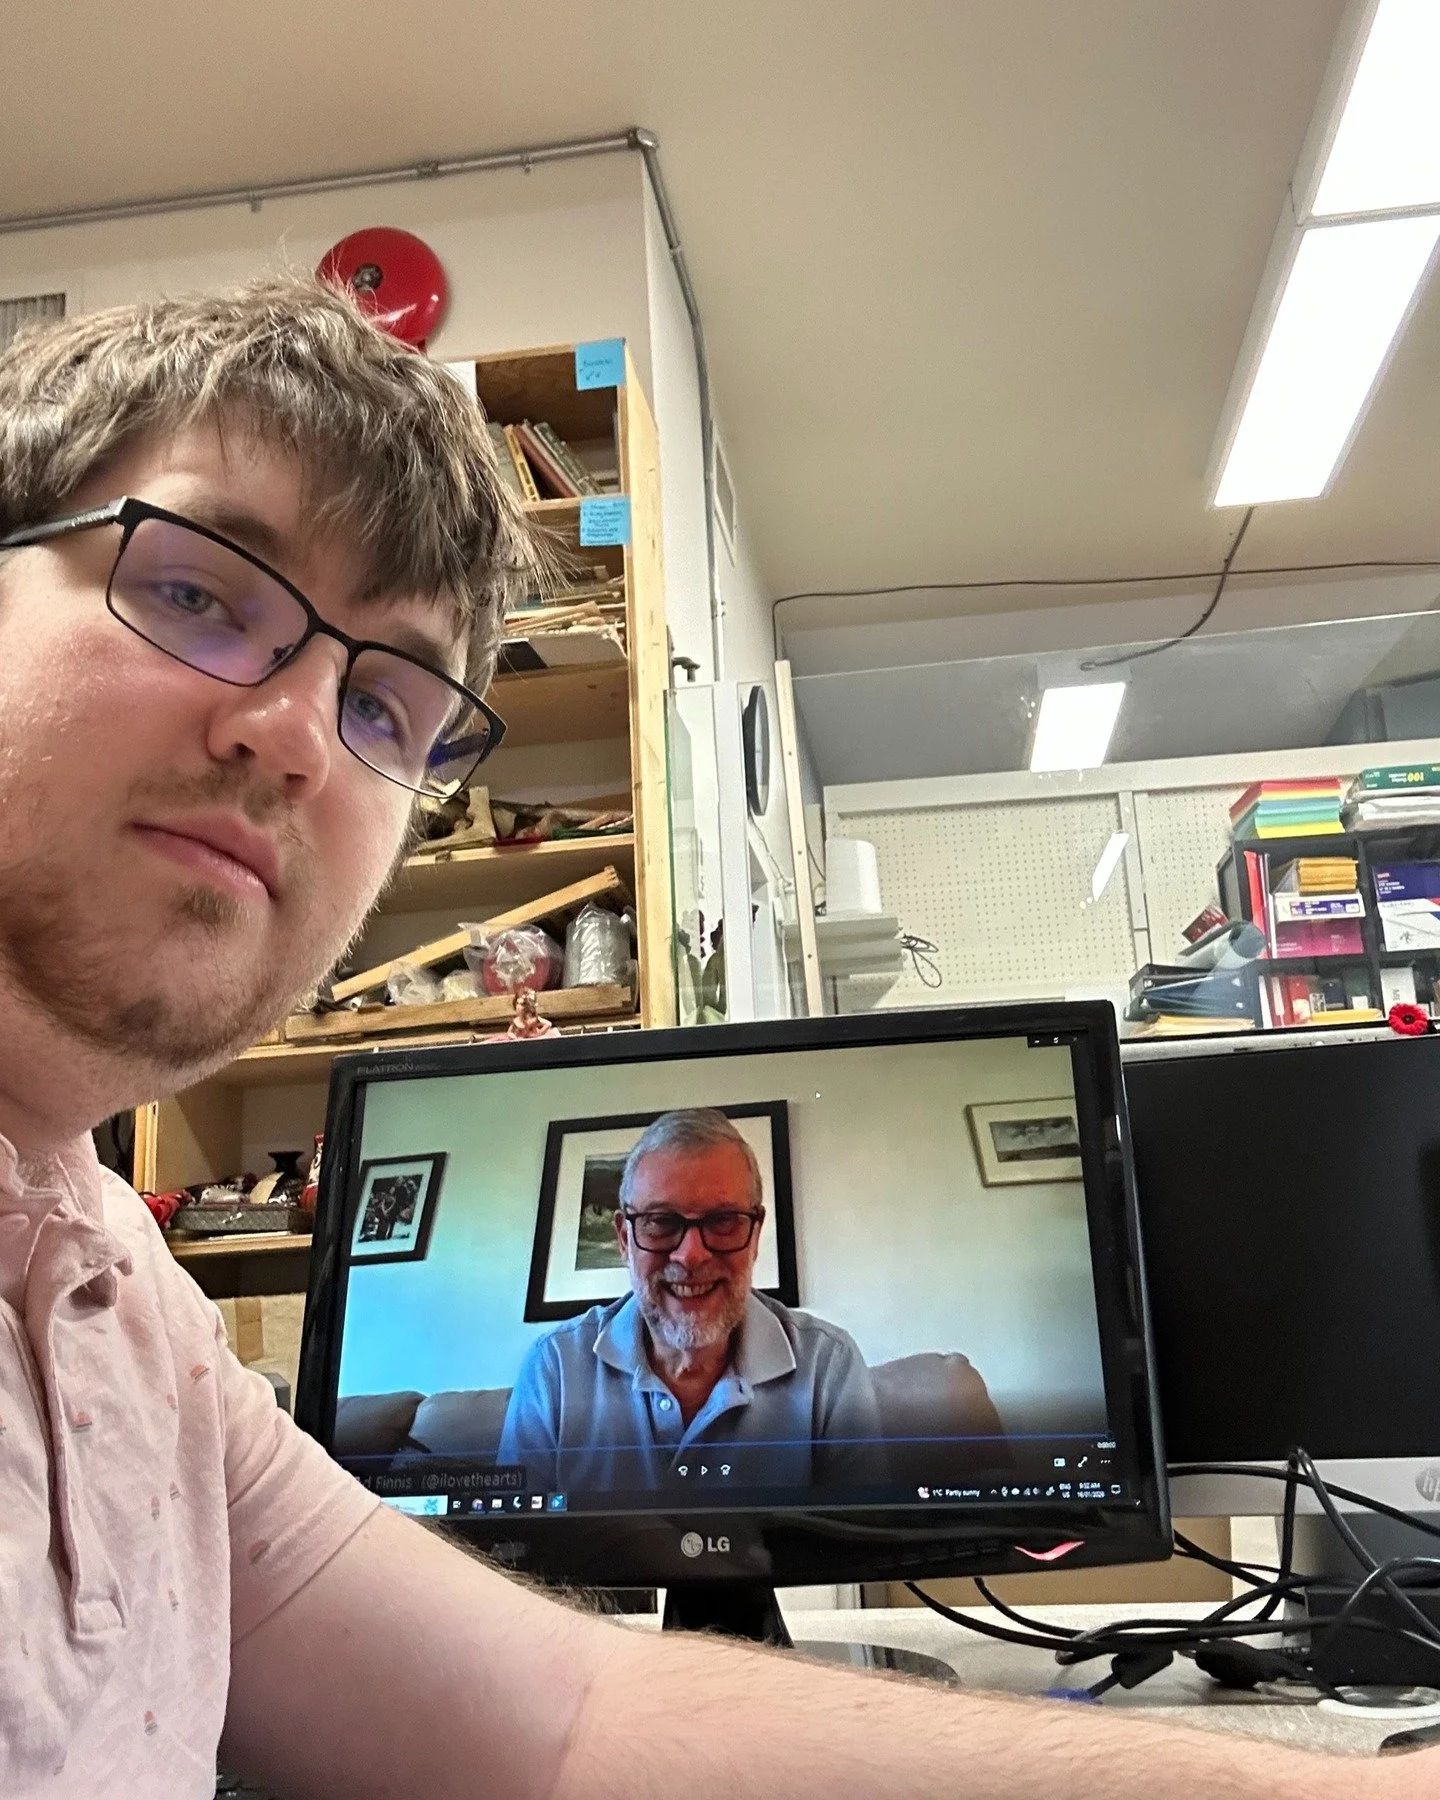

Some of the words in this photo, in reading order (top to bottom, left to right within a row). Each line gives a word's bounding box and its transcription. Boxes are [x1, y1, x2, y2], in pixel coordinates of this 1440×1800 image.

[421, 1472, 523, 1491] (@ilovethearts)
[945, 1488, 962, 1498] Partly
[963, 1488, 981, 1498] sunny
[707, 1536, 731, 1552] LG
